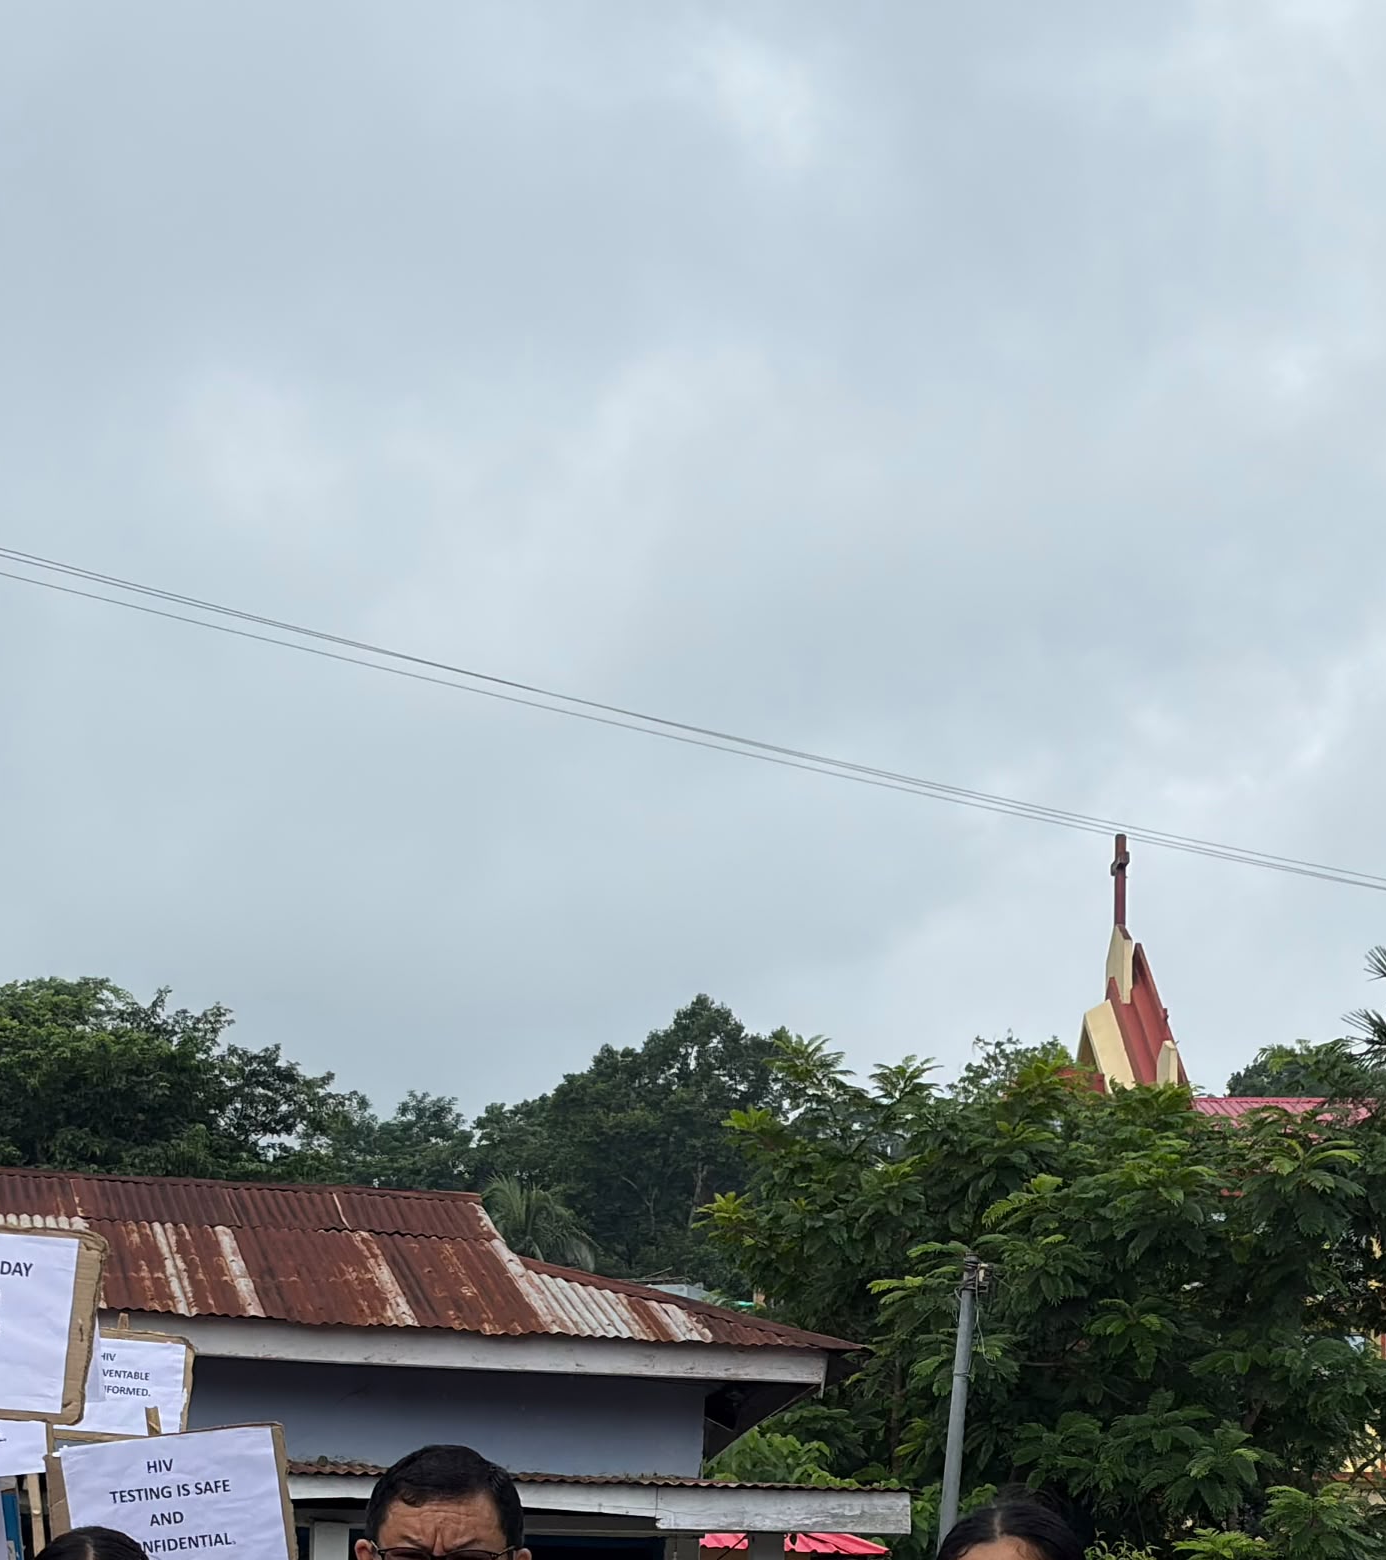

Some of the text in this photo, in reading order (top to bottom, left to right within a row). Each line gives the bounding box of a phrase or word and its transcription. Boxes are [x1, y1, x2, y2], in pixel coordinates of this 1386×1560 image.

[103, 1369, 150, 1380] VENTABLE
[104, 1385, 151, 1397] FORMED.
[146, 1459, 174, 1473] HIV
[109, 1480, 231, 1504] TESTING IS SAFE
[150, 1511, 184, 1526] AND
[143, 1533, 236, 1553] NFIDENTIAL.
